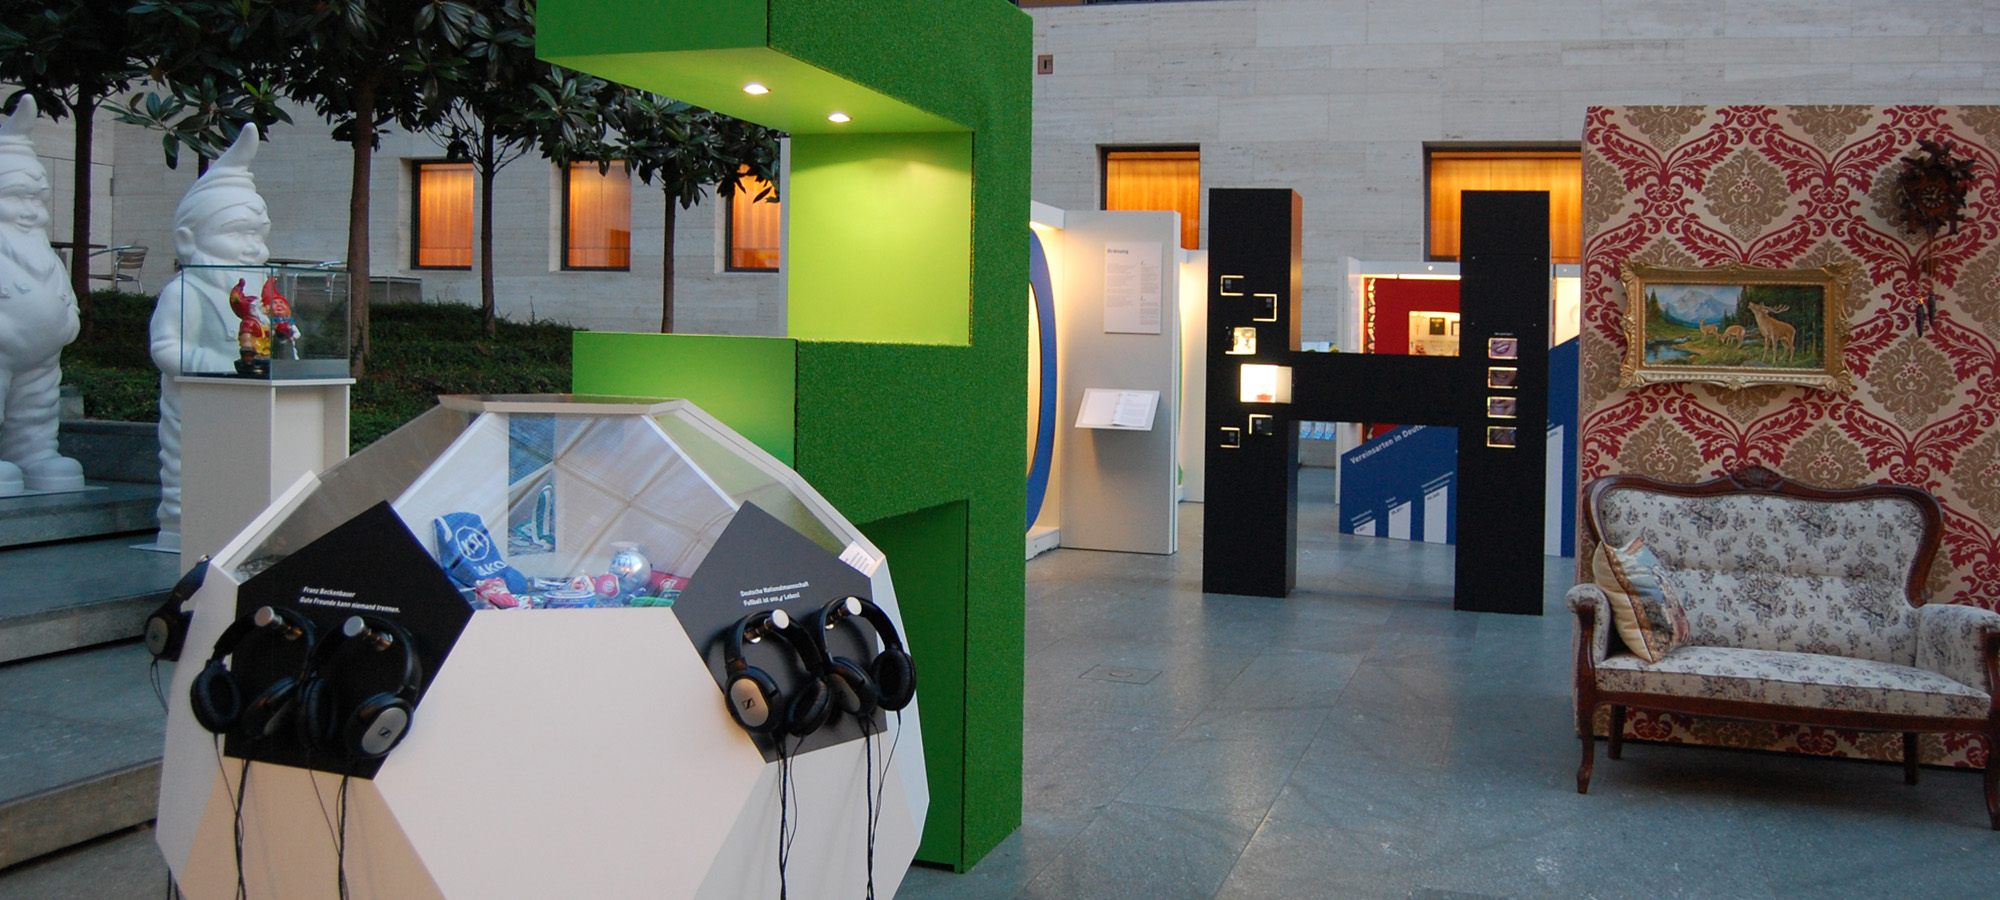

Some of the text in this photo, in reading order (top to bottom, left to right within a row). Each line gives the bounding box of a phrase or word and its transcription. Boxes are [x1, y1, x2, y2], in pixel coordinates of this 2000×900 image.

[1349, 438, 1394, 464] Vereinsarten
[1394, 433, 1403, 443] in
[303, 586, 356, 598] Franz Beckenbauer
[299, 596, 313, 604] Gute
[313, 597, 337, 606] Freunde
[351, 602, 376, 610] niemand
